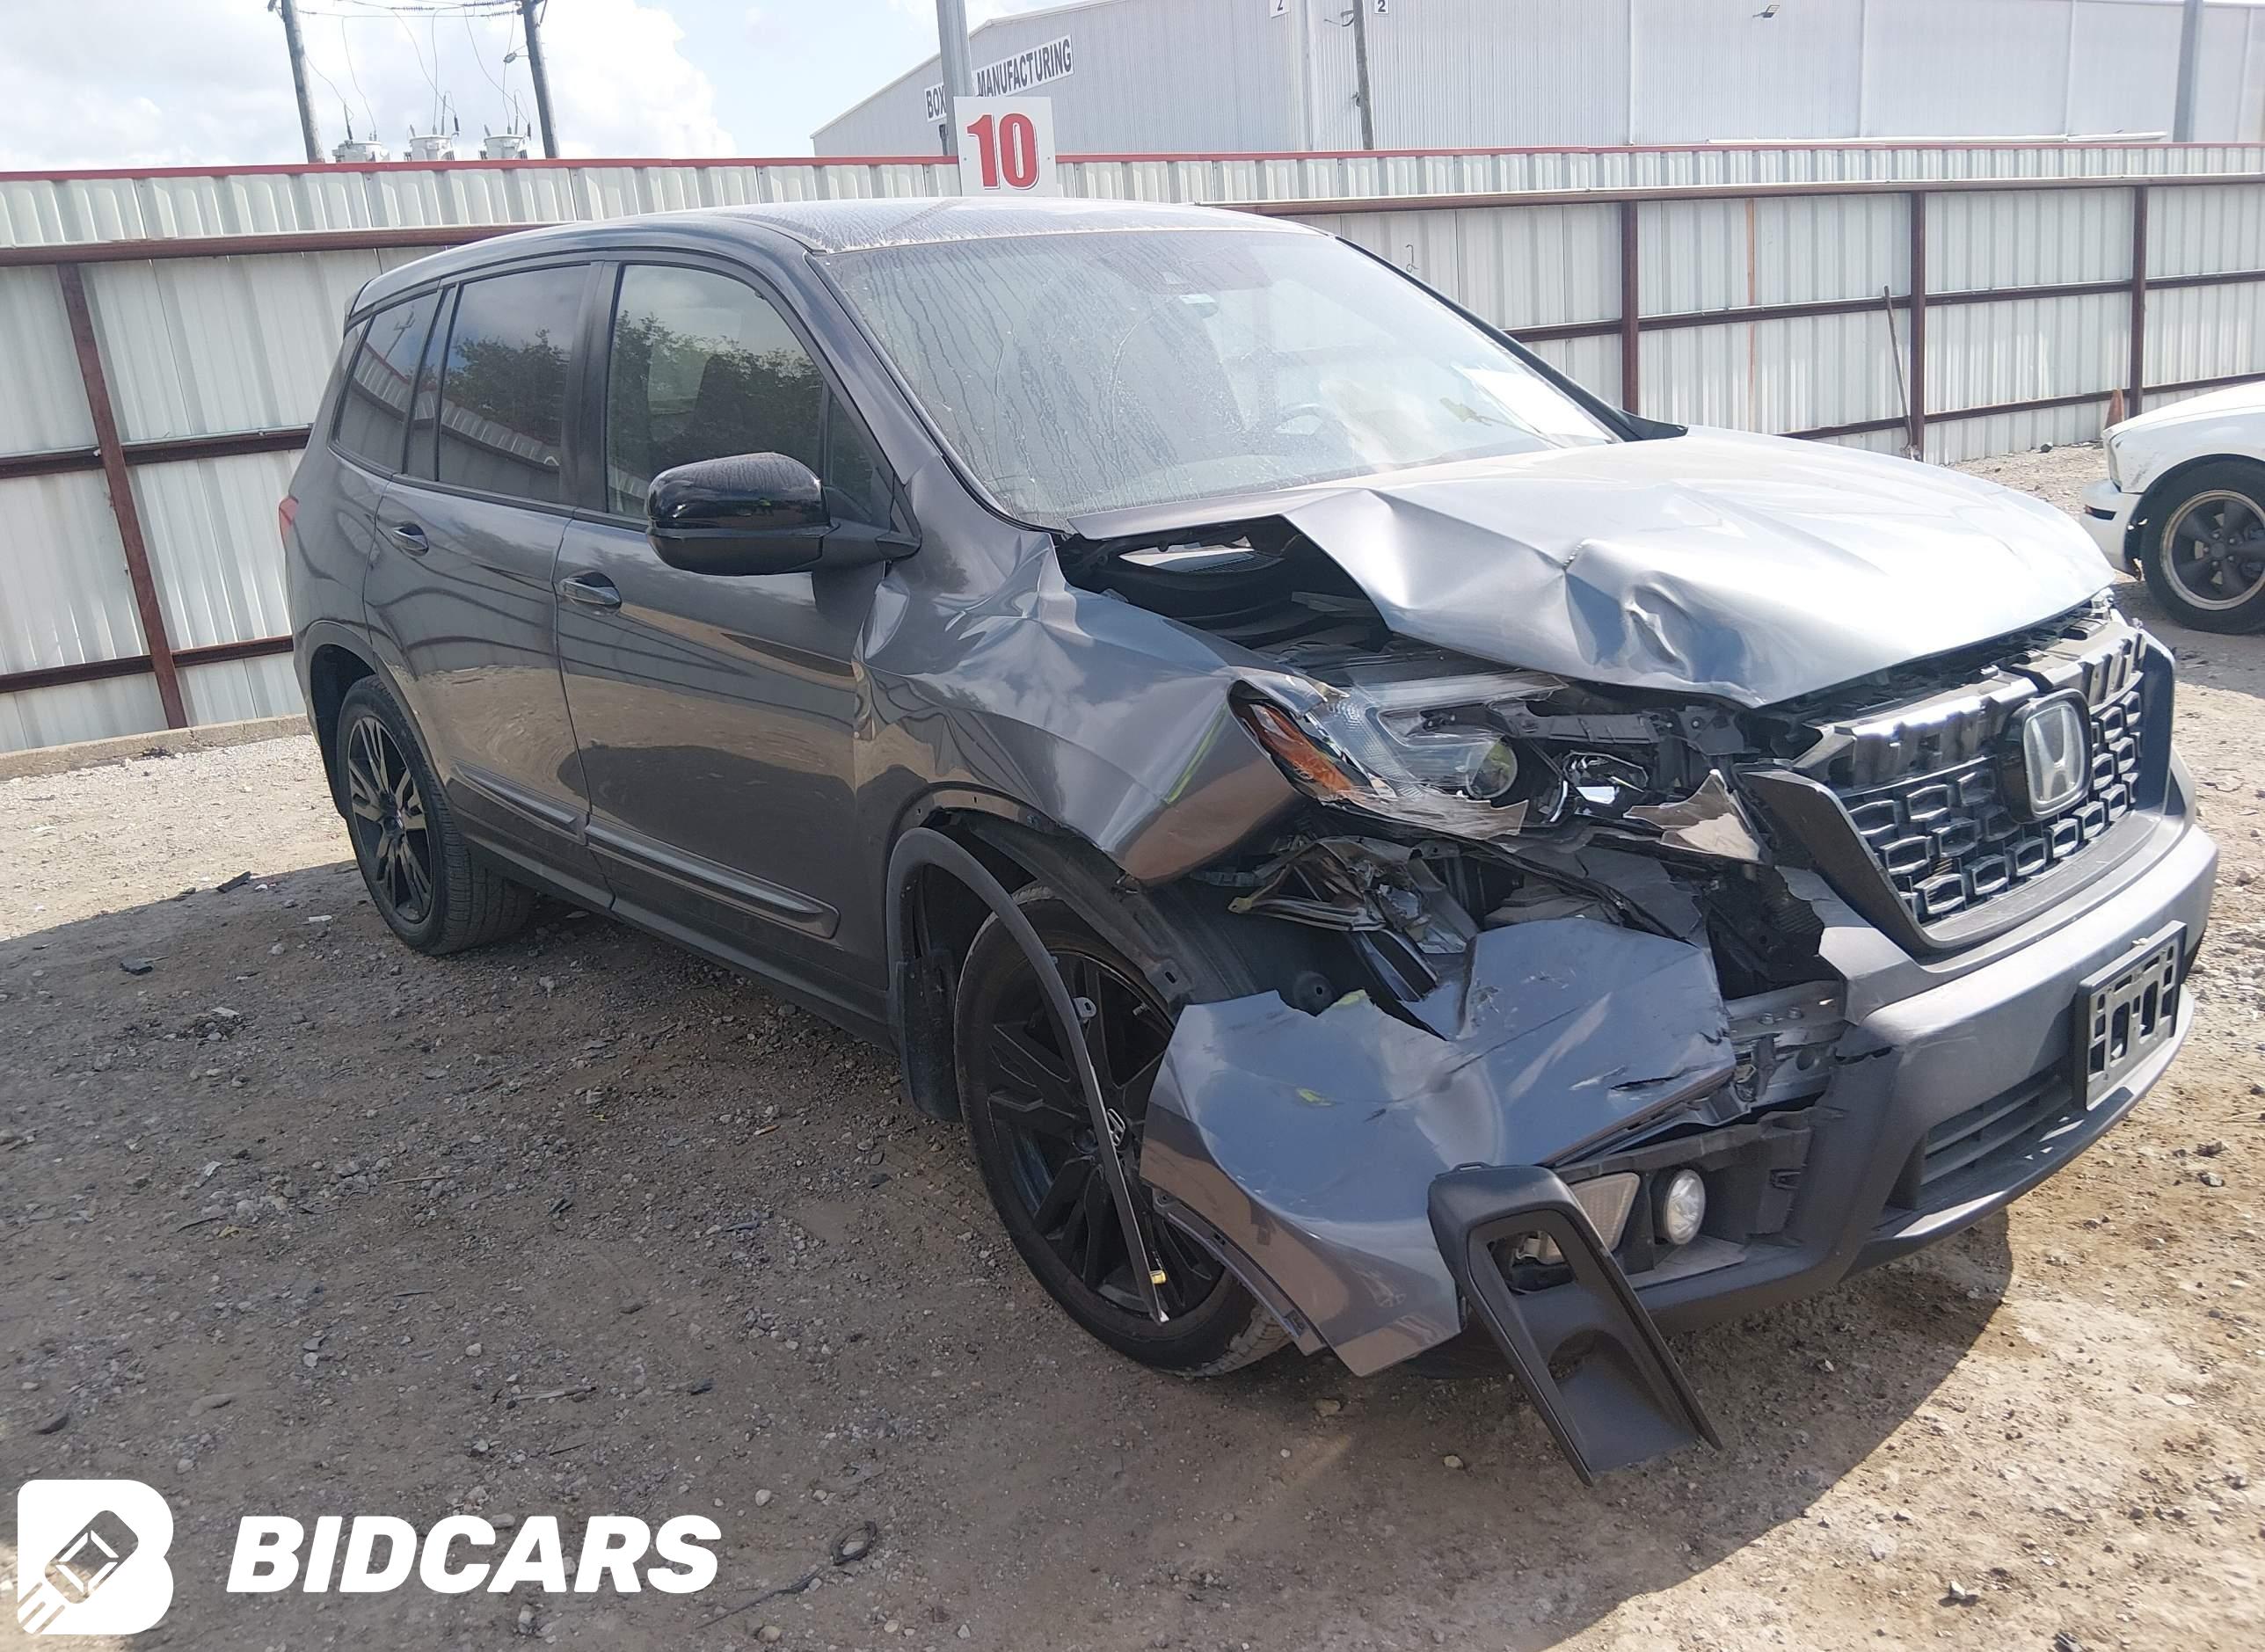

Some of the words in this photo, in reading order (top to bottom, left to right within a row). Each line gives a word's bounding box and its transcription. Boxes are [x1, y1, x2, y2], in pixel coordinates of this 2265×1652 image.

[1377, 0, 1387, 12] 2
[977, 38, 1072, 97] MANUFACTURING
[967, 113, 1038, 189] 10
